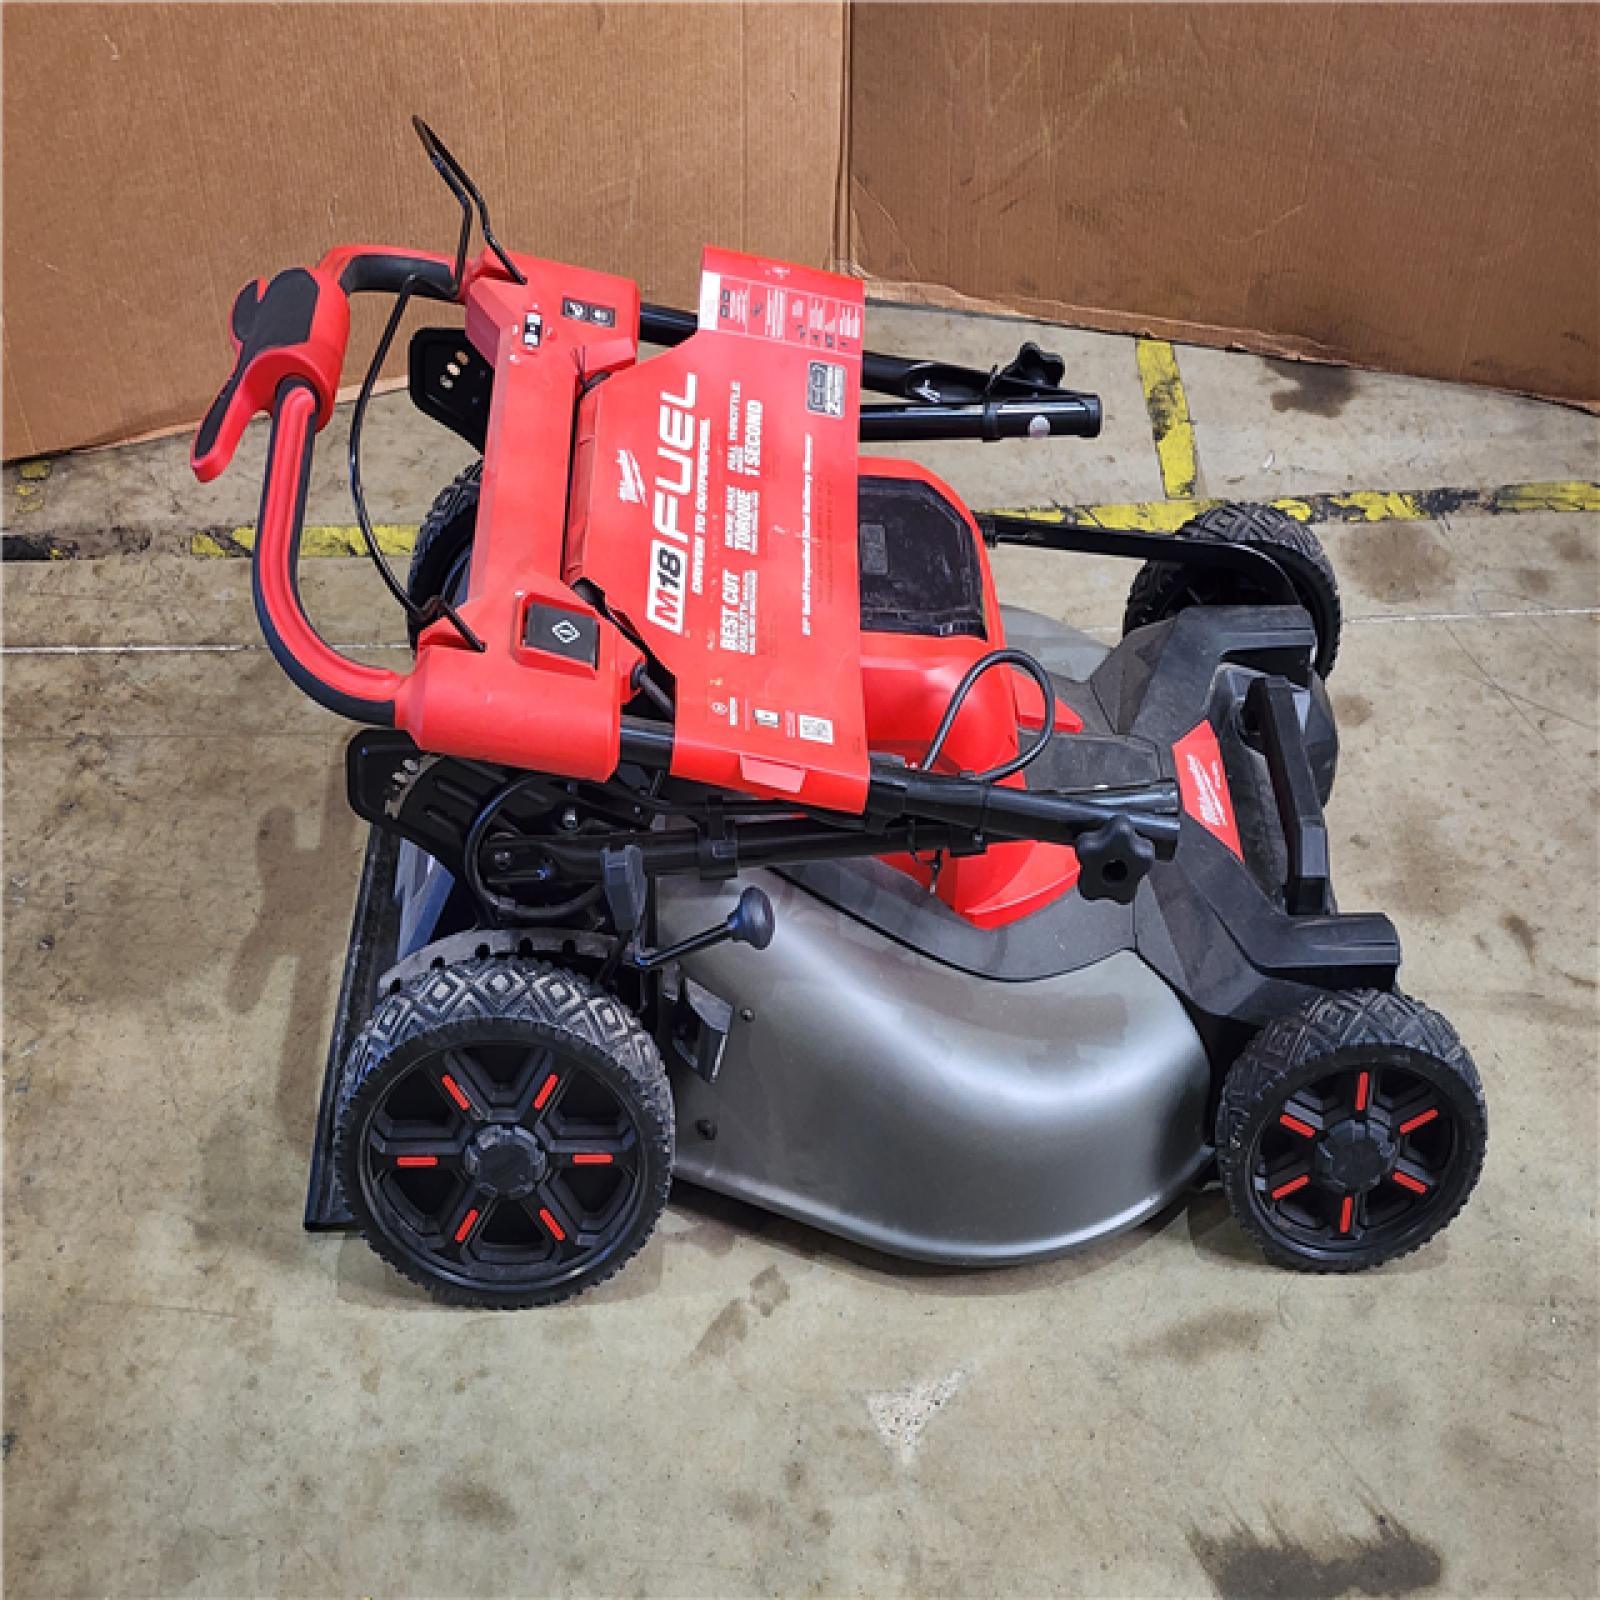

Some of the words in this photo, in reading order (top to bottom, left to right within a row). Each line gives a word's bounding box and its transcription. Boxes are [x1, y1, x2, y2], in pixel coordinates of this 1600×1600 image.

[728, 380, 741, 441] THROTTLE
[744, 399, 763, 467] SECOND
[652, 373, 697, 544] FUEL
[694, 513, 706, 534] TO
[734, 489, 752, 551] TORQUE
[653, 547, 683, 627] M18
[692, 535, 705, 596] DRIVEN
[721, 569, 740, 605] CUT
[719, 604, 740, 651] BEST
